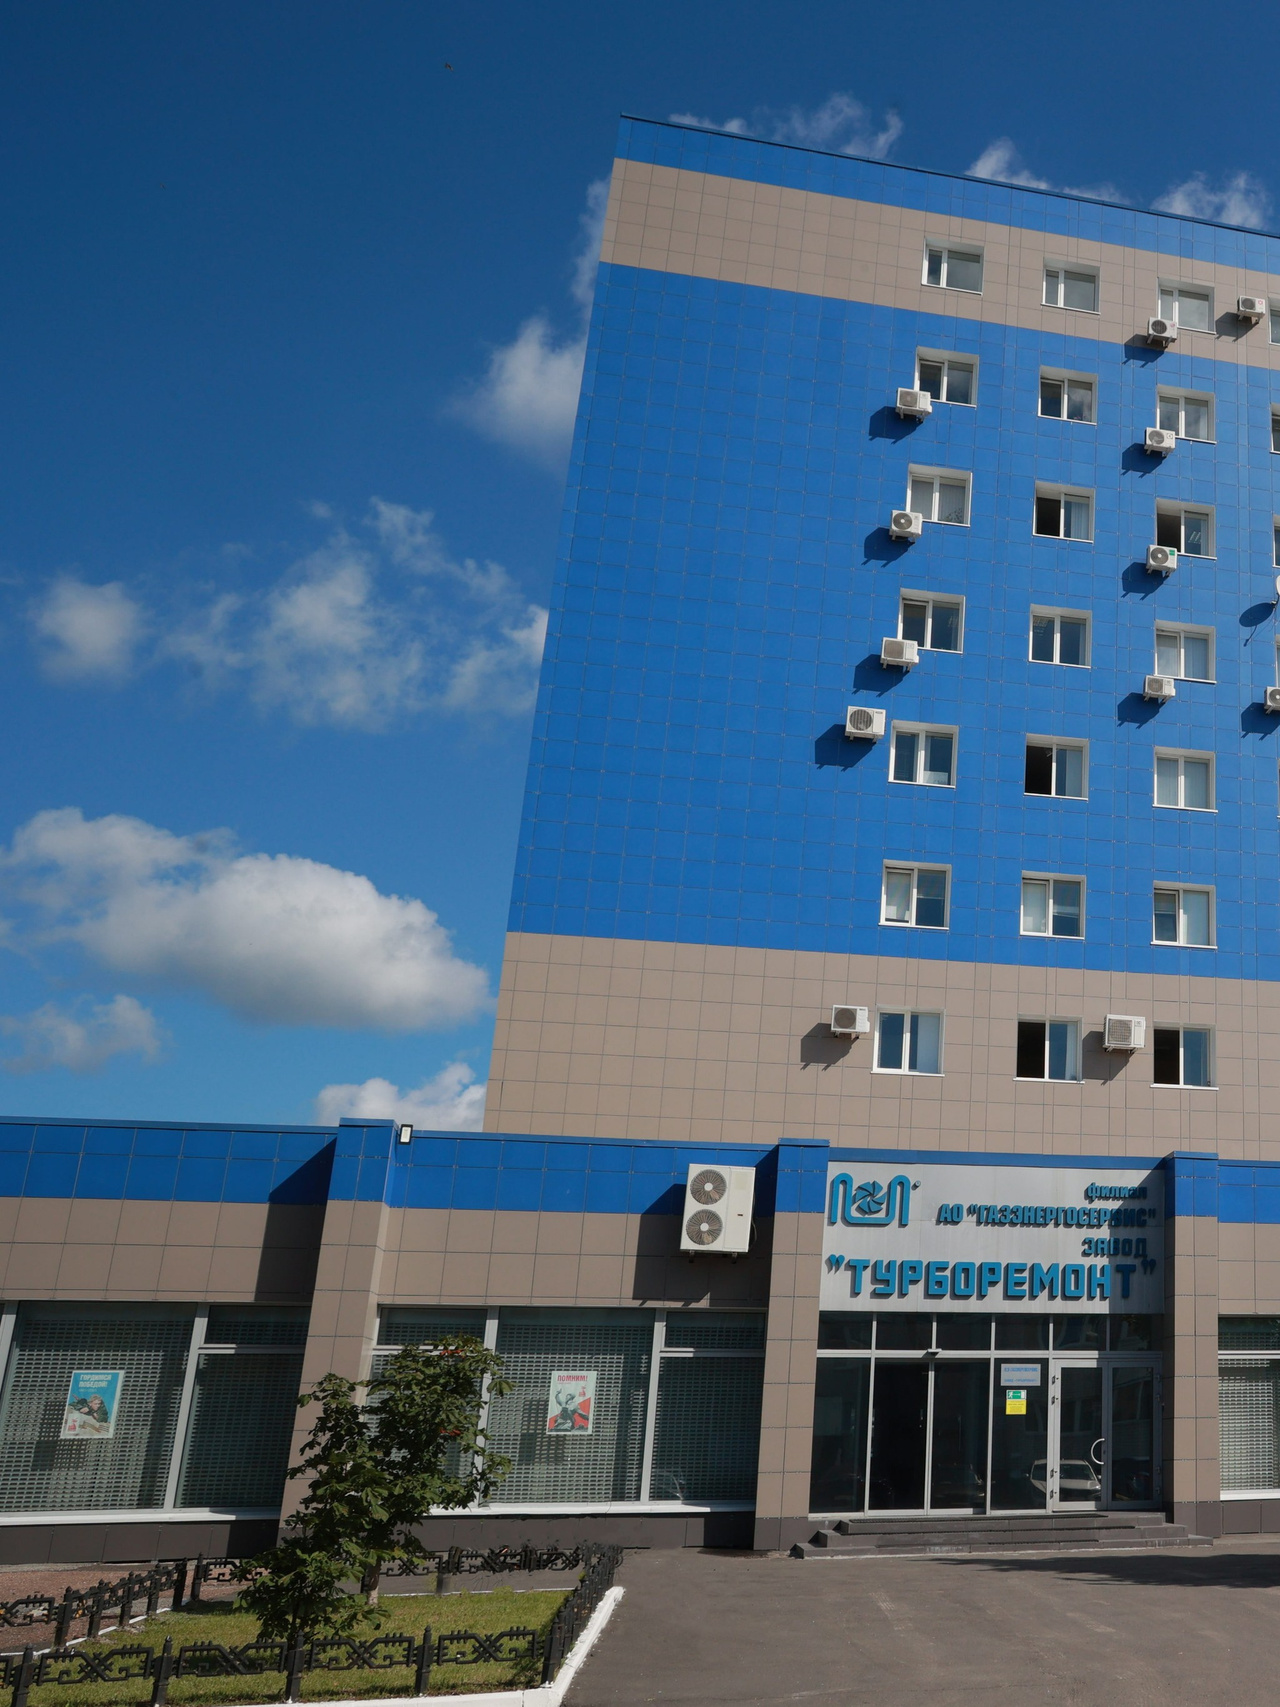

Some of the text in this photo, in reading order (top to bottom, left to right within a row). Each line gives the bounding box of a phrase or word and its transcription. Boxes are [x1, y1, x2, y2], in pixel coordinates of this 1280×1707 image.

[1087, 1183, 1147, 1203] филиал
[939, 1204, 1156, 1228] АО "ГАЗЭНЕРГОСЕРВИС"
[1084, 1237, 1148, 1257] ЗАВОД
[828, 1253, 1156, 1299] "ТУРБОРЕМОНТ"
